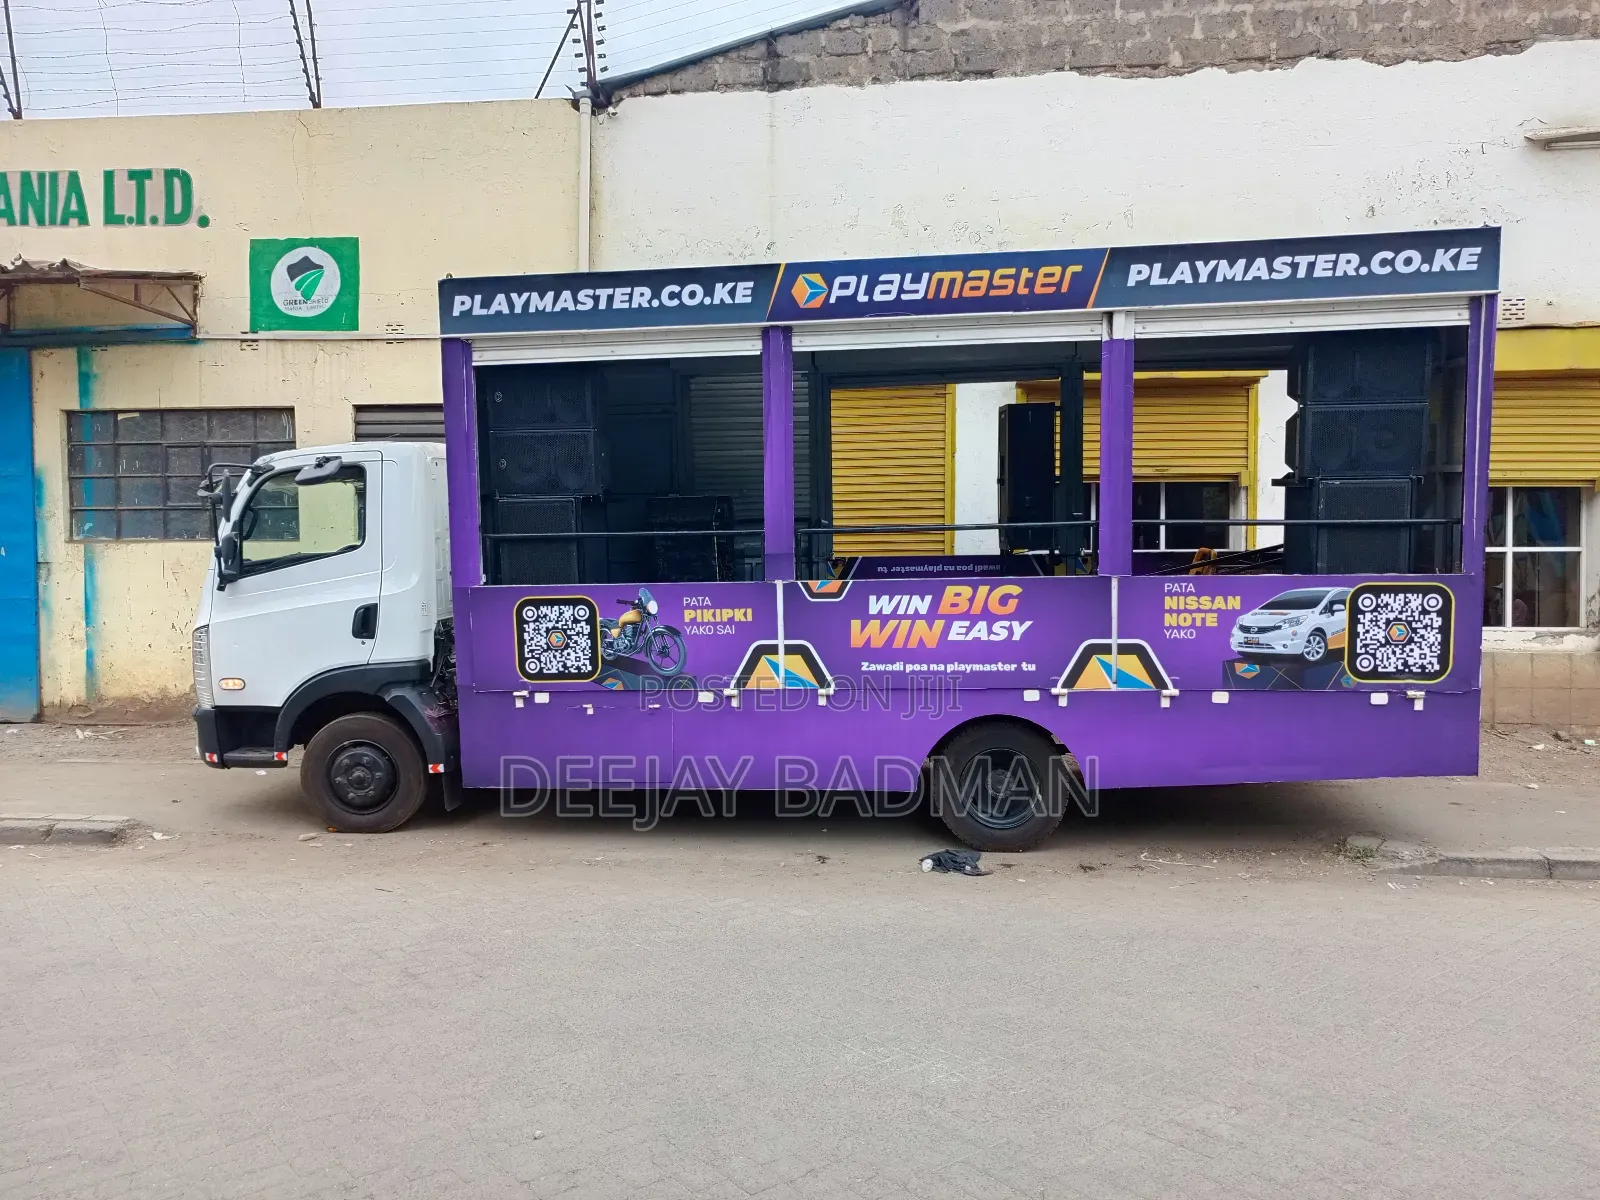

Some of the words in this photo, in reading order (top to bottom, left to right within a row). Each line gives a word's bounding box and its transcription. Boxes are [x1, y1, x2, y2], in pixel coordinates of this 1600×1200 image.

[0, 170, 90, 226] ANIA
[102, 168, 211, 229] L.T.D.
[1127, 246, 1482, 288] PLAYMASTER.CO.KE
[452, 280, 754, 317] PLAYMASTER.CO.KE
[1164, 582, 1195, 593] PATA
[683, 596, 711, 607] PATA
[868, 595, 932, 615] WIN
[937, 584, 1023, 615] BIG
[1164, 595, 1241, 611] NISSAN
[684, 608, 753, 623] PIKIPKI
[1164, 612, 1218, 627] NOTE
[683, 625, 714, 635] YAKO
[716, 624, 735, 635] SAI
[850, 619, 945, 649] WIN
[947, 620, 1034, 642] EASY
[1164, 628, 1196, 640] YAKO
[861, 661, 904, 671] Zawadi
[905, 663, 928, 673] poa
[929, 663, 945, 671] na
[946, 661, 1018, 674] playmaster
[1021, 662, 1036, 671] tu
